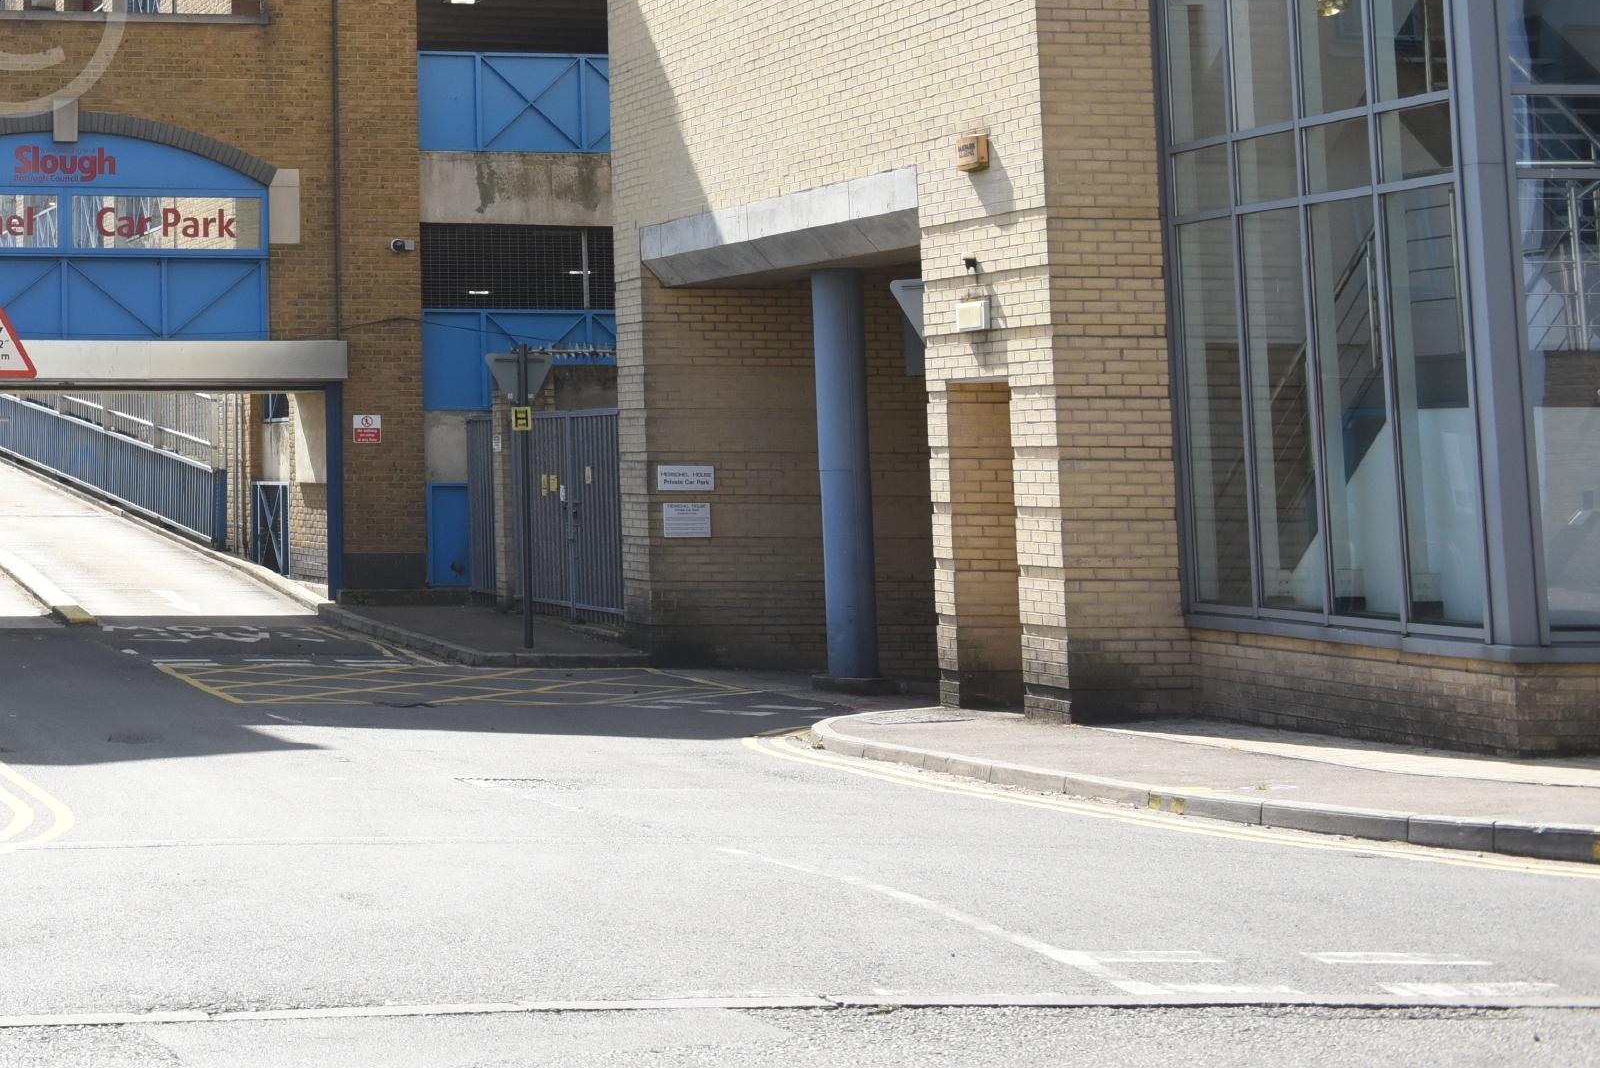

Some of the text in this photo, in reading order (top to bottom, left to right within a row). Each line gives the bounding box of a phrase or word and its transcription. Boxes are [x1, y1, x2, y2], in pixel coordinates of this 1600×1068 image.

[14, 145, 116, 182] Slough
[96, 206, 152, 238] Car
[162, 207, 236, 238] Park
